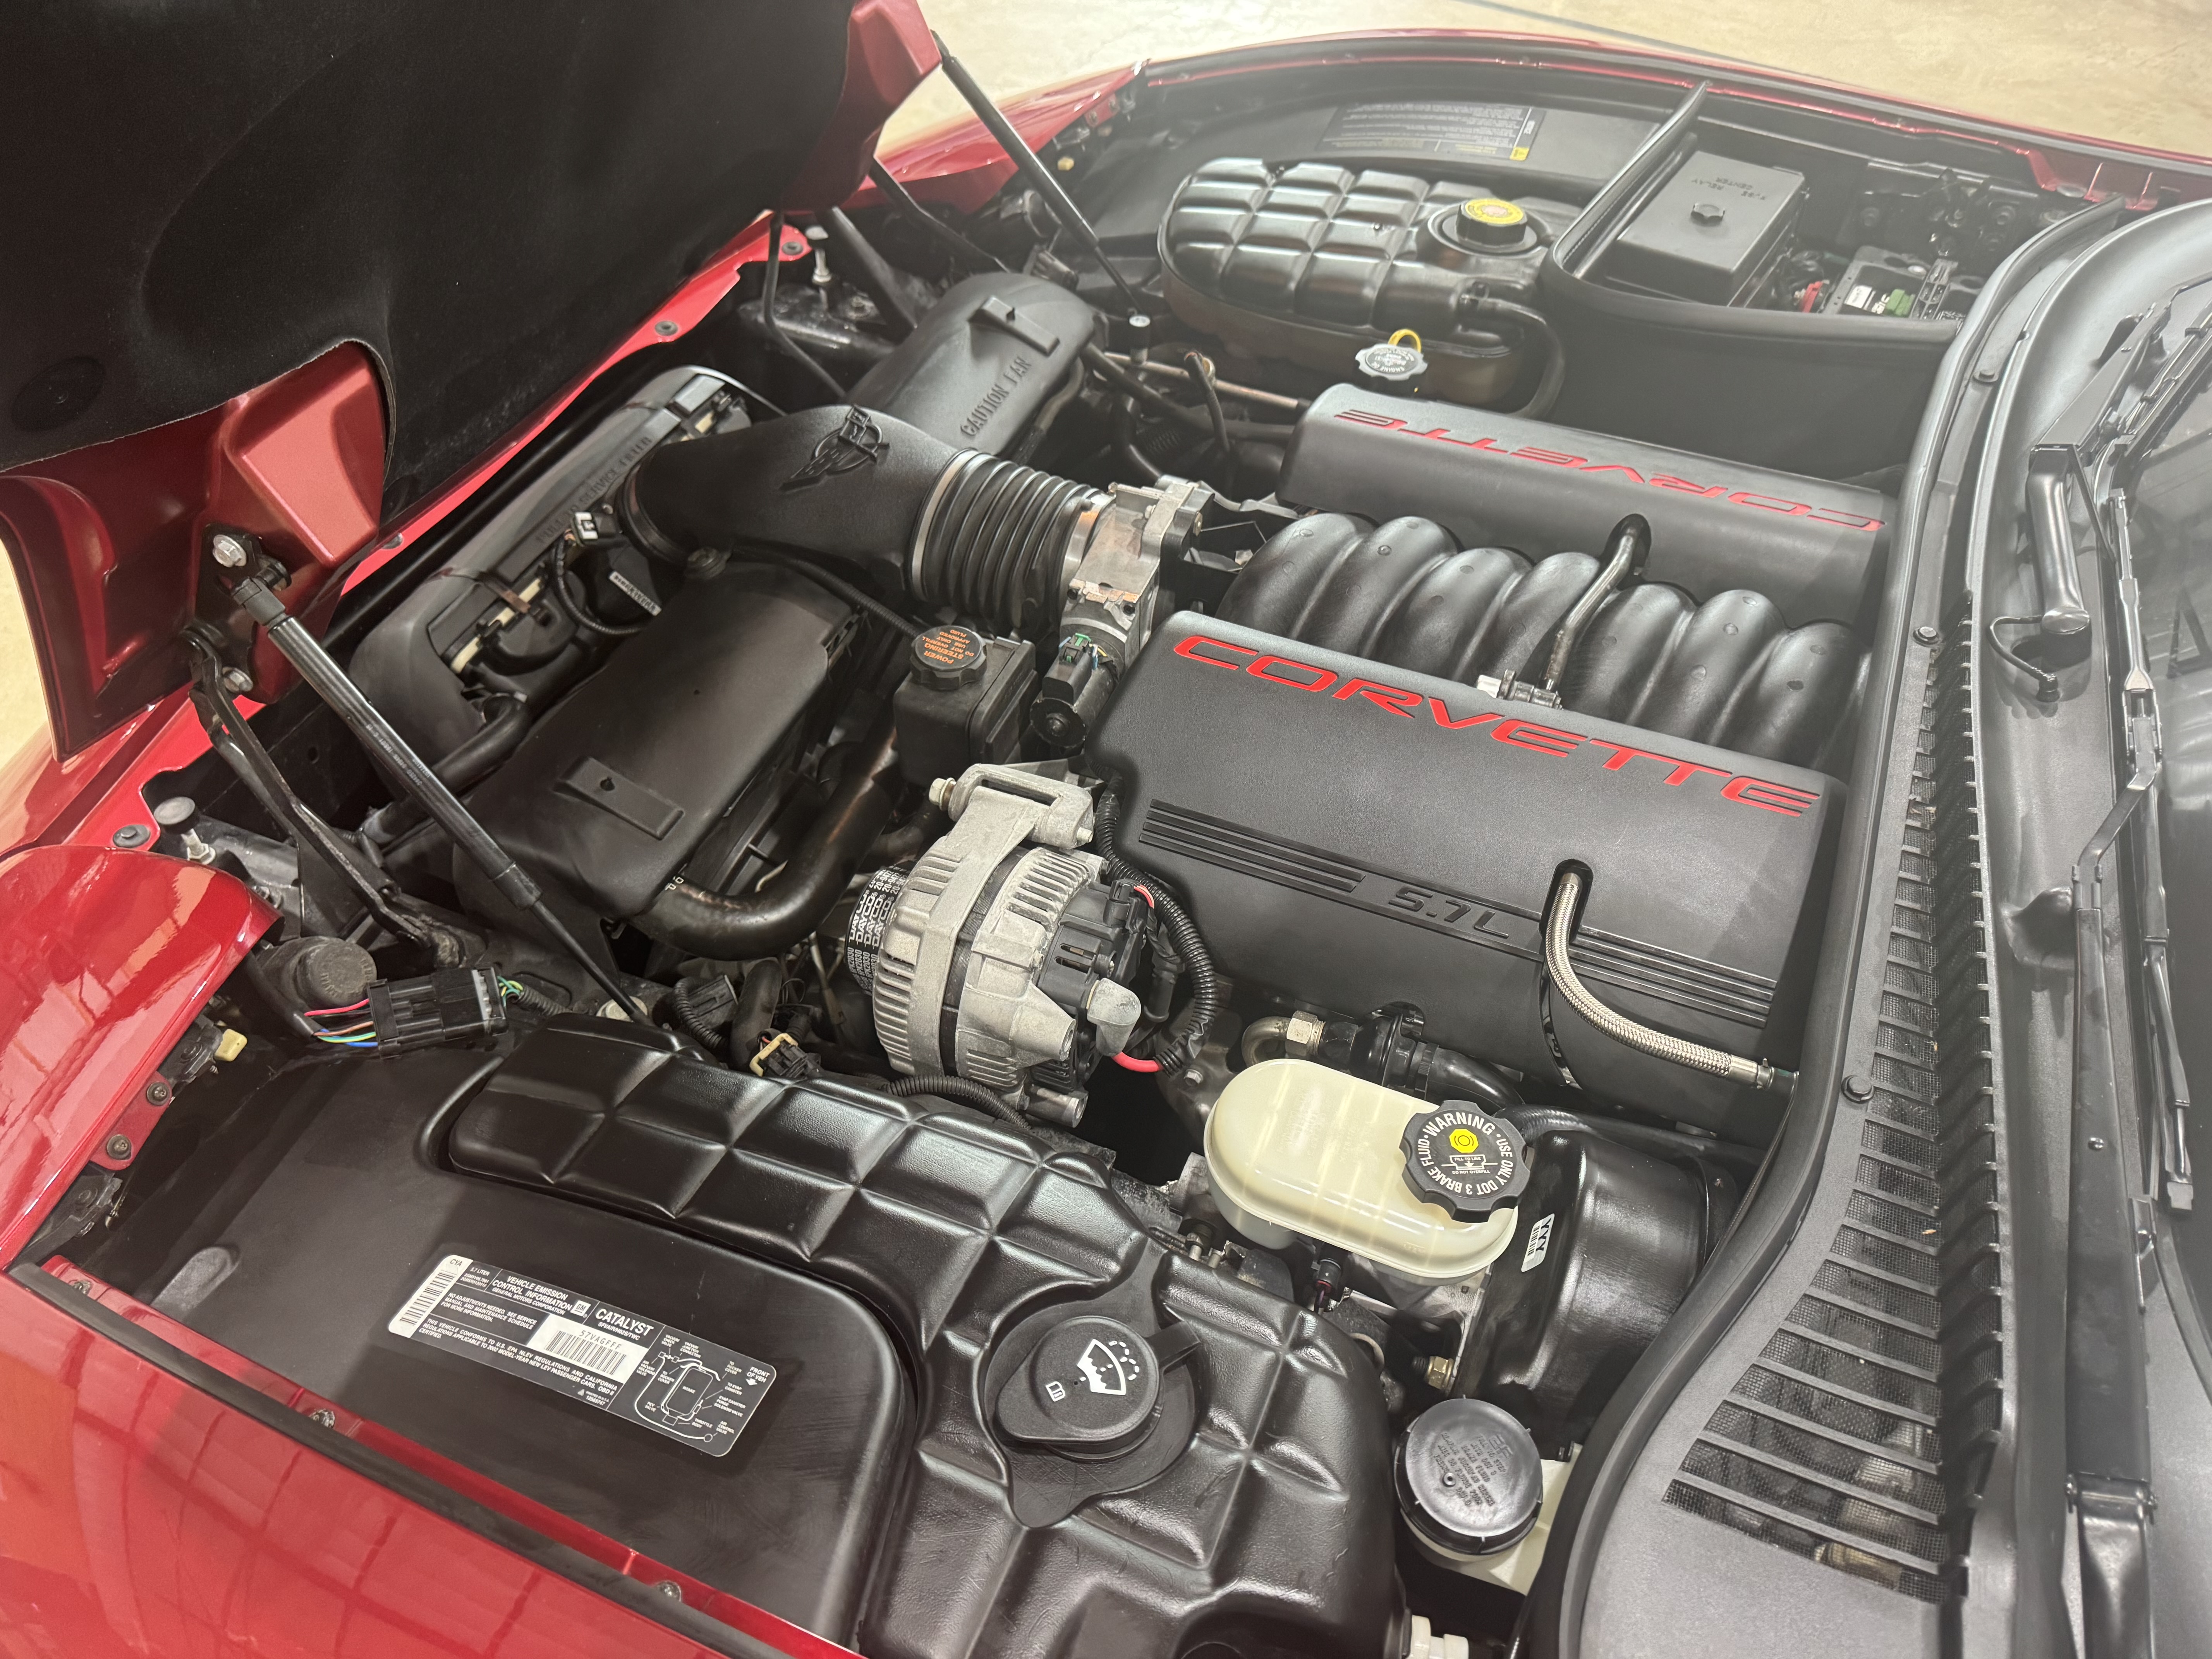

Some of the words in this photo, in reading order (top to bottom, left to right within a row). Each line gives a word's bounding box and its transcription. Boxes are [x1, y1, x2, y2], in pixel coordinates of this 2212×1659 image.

[960, 383, 1010, 436] CAUTION
[1003, 356, 1032, 385] FAN
[1333, 408, 1887, 532] CORVETTE
[922, 636, 948, 648] OVERFILL
[939, 632, 970, 644] APPROVED
[950, 630, 967, 638] FLUID
[924, 642, 964, 659] STEERING
[924, 651, 954, 664] POWER
[1174, 634, 1821, 817] CORVETTE
[1388, 885, 1509, 939] 5.7L
[1422, 1112, 1495, 1137] WARNING
[1418, 1139, 1434, 1167] FLUID
[1496, 1139, 1513, 1158] USE
[1427, 1166, 1462, 1193] BRAKE
[1495, 1160, 1513, 1185] ONLY
[1465, 1184, 1473, 1195] 3
[1476, 1180, 1499, 1195] DOT
[1535, 1217, 1552, 1252] YYY
[450, 1258, 462, 1266] CYA
[491, 1286, 513, 1297] GENERAL
[512, 1293, 533, 1304] MOTORS
[531, 1300, 566, 1315] CORPORATION
[492, 1279, 523, 1295] CONTROL
[524, 1290, 573, 1311] INFORMATION
[507, 1275, 536, 1290] VEHICLE
[534, 1285, 568, 1301] EMISSION
[444, 1296, 463, 1307] MANUAL
[474, 1306, 508, 1321] MAINTENANCE
[507, 1317, 534, 1330] SCHEDULE
[450, 1304, 464, 1312] MORE
[462, 1308, 493, 1322] INFORMATION.
[454, 1294, 487, 1310] ADJUSTMENTS
[486, 1304, 505, 1316] NEEDED.
[516, 1314, 538, 1325] SERVICE
[575, 1303, 586, 1311] GM
[418, 1327, 442, 1339] CERTIFIED.
[595, 1308, 654, 1336] CATALYST
[579, 1329, 622, 1350] 57VAGFFF
[422, 1322, 453, 1336] REGULATIONS
[452, 1333, 481, 1346] APPLICABLE
[528, 1359, 541, 1367] NEW
[550, 1367, 581, 1382] PASSENGER
[580, 1379, 596, 1389] CARS.
[598, 1386, 610, 1394] OBD
[438, 1322, 460, 1333] VEHICLE
[459, 1329, 487, 1343] CONFORMS
[495, 1341, 505, 1349] U.S.
[518, 1350, 534, 1358] NLEV
[533, 1355, 570, 1372] REGULATIONS
[571, 1369, 584, 1377] AND
[584, 1374, 618, 1391] CALIFORNIA
[749, 1366, 770, 1377] FRONT
[755, 1374, 766, 1383] VEH
